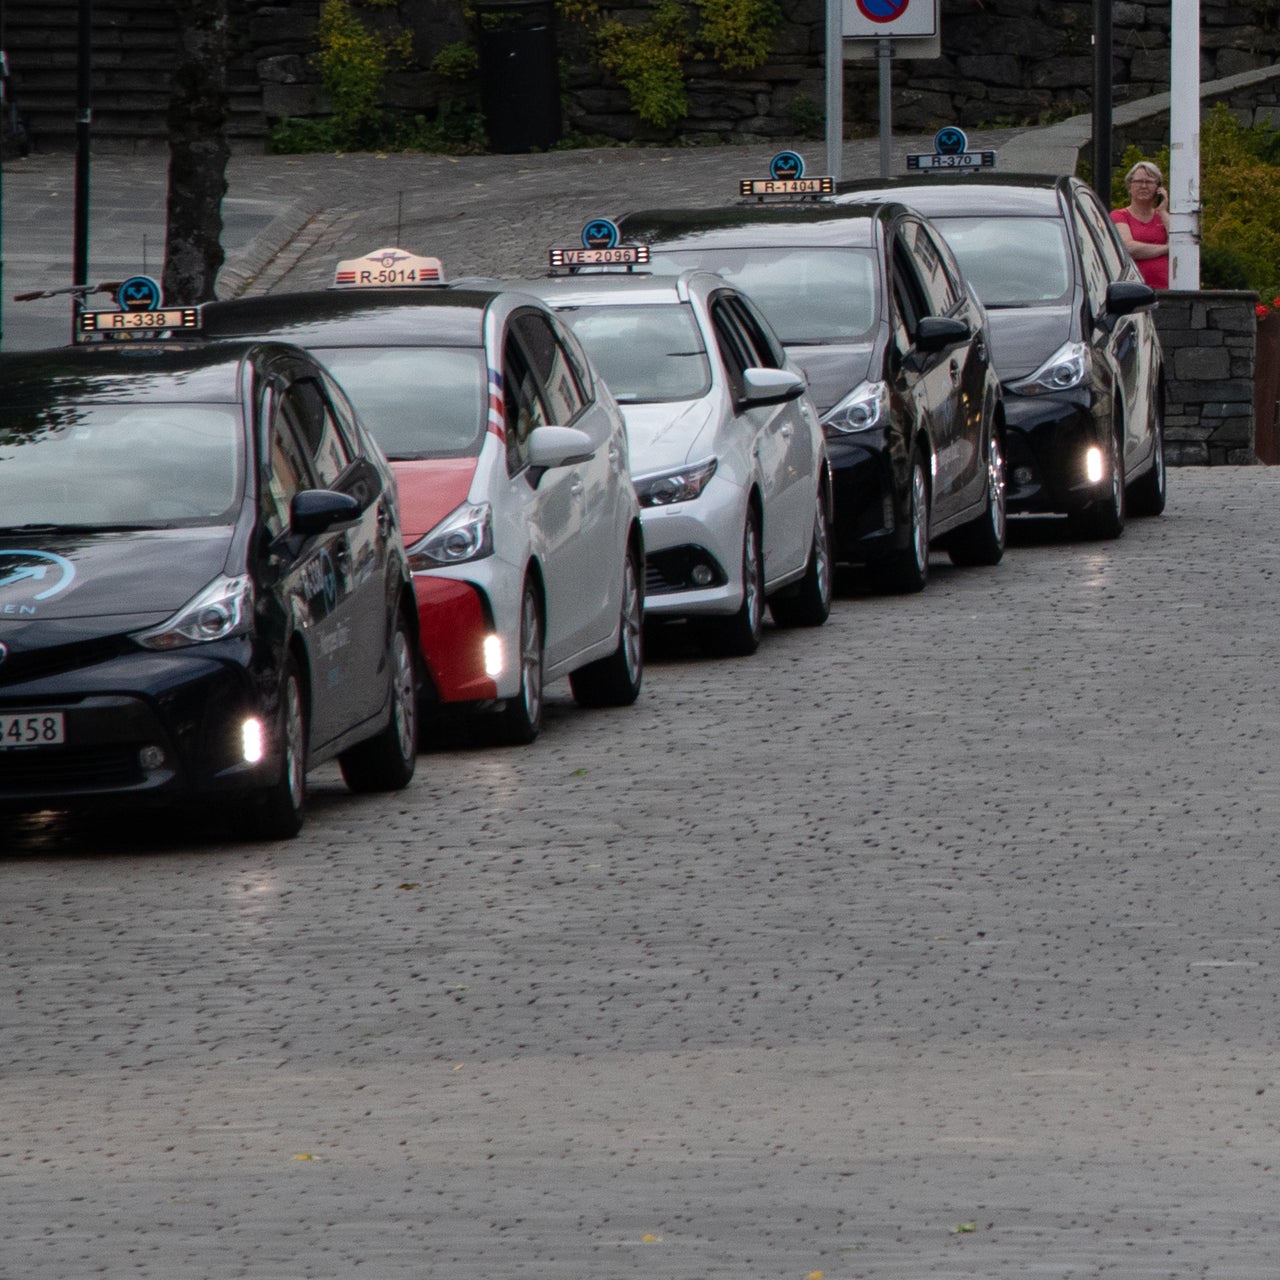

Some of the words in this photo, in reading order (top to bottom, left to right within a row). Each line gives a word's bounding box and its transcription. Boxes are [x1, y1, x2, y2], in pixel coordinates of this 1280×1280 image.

[932, 156, 972, 166] R-370
[765, 182, 815, 193] R-1404
[566, 250, 632, 263] VE-2096
[360, 269, 416, 284] R-5014
[113, 314, 166, 328] R-338
